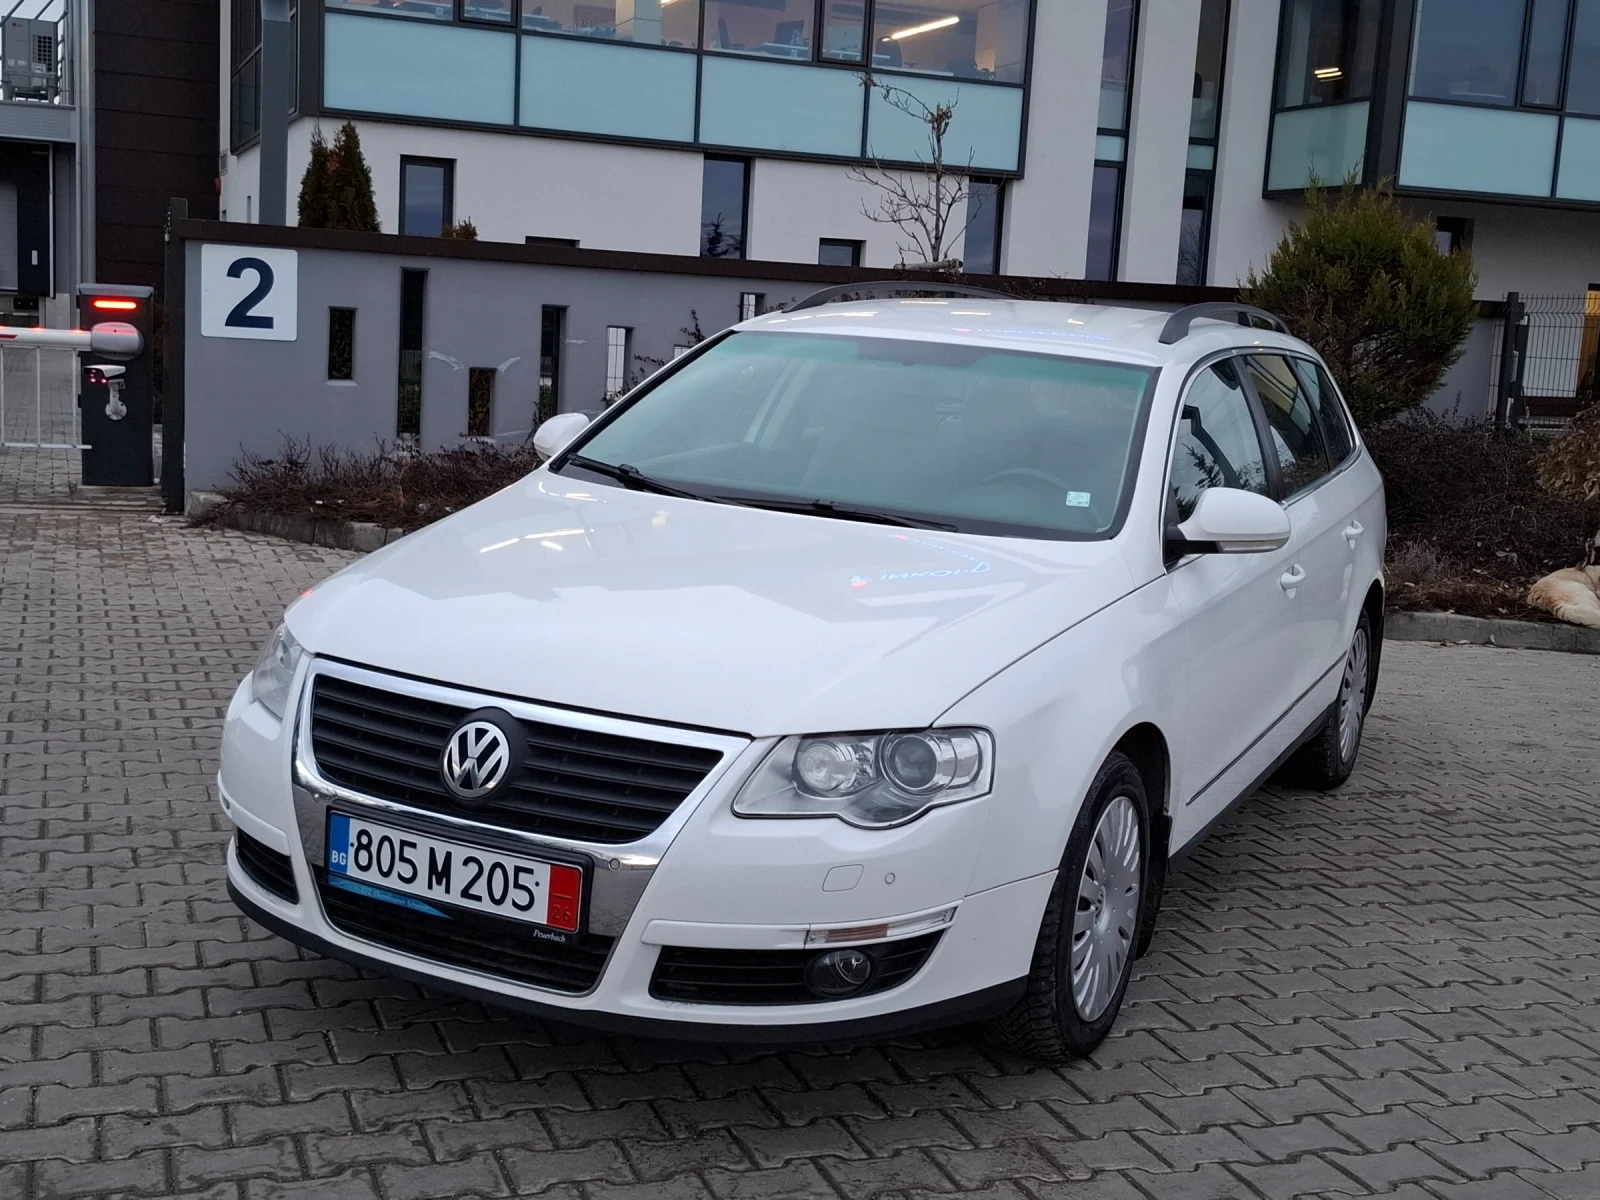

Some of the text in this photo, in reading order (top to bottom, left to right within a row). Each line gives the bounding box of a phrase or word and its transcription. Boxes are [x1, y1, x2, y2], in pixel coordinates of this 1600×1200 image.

[225, 257, 274, 329] 2
[332, 850, 347, 866] BG
[354, 829, 535, 912] 805 M 205
[552, 904, 572, 922] 26
